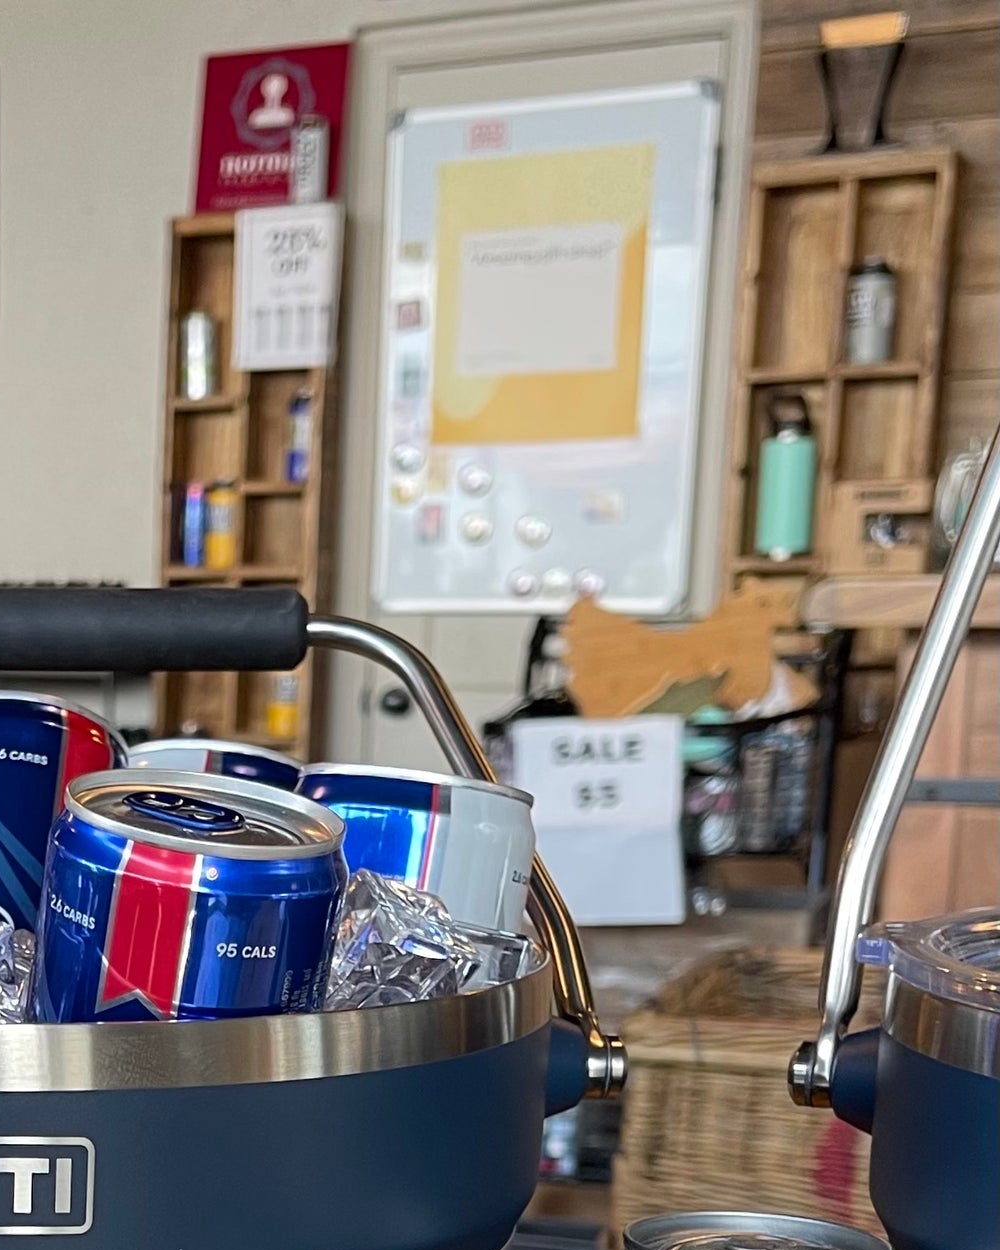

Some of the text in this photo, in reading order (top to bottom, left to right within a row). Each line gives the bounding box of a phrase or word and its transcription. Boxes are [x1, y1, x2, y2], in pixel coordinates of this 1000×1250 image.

[9, 750, 48, 766] CARBS
[551, 733, 646, 766] SALE
[50, 894, 96, 930] 2.6 CARBS
[216, 943, 276, 959] 95 CALS
